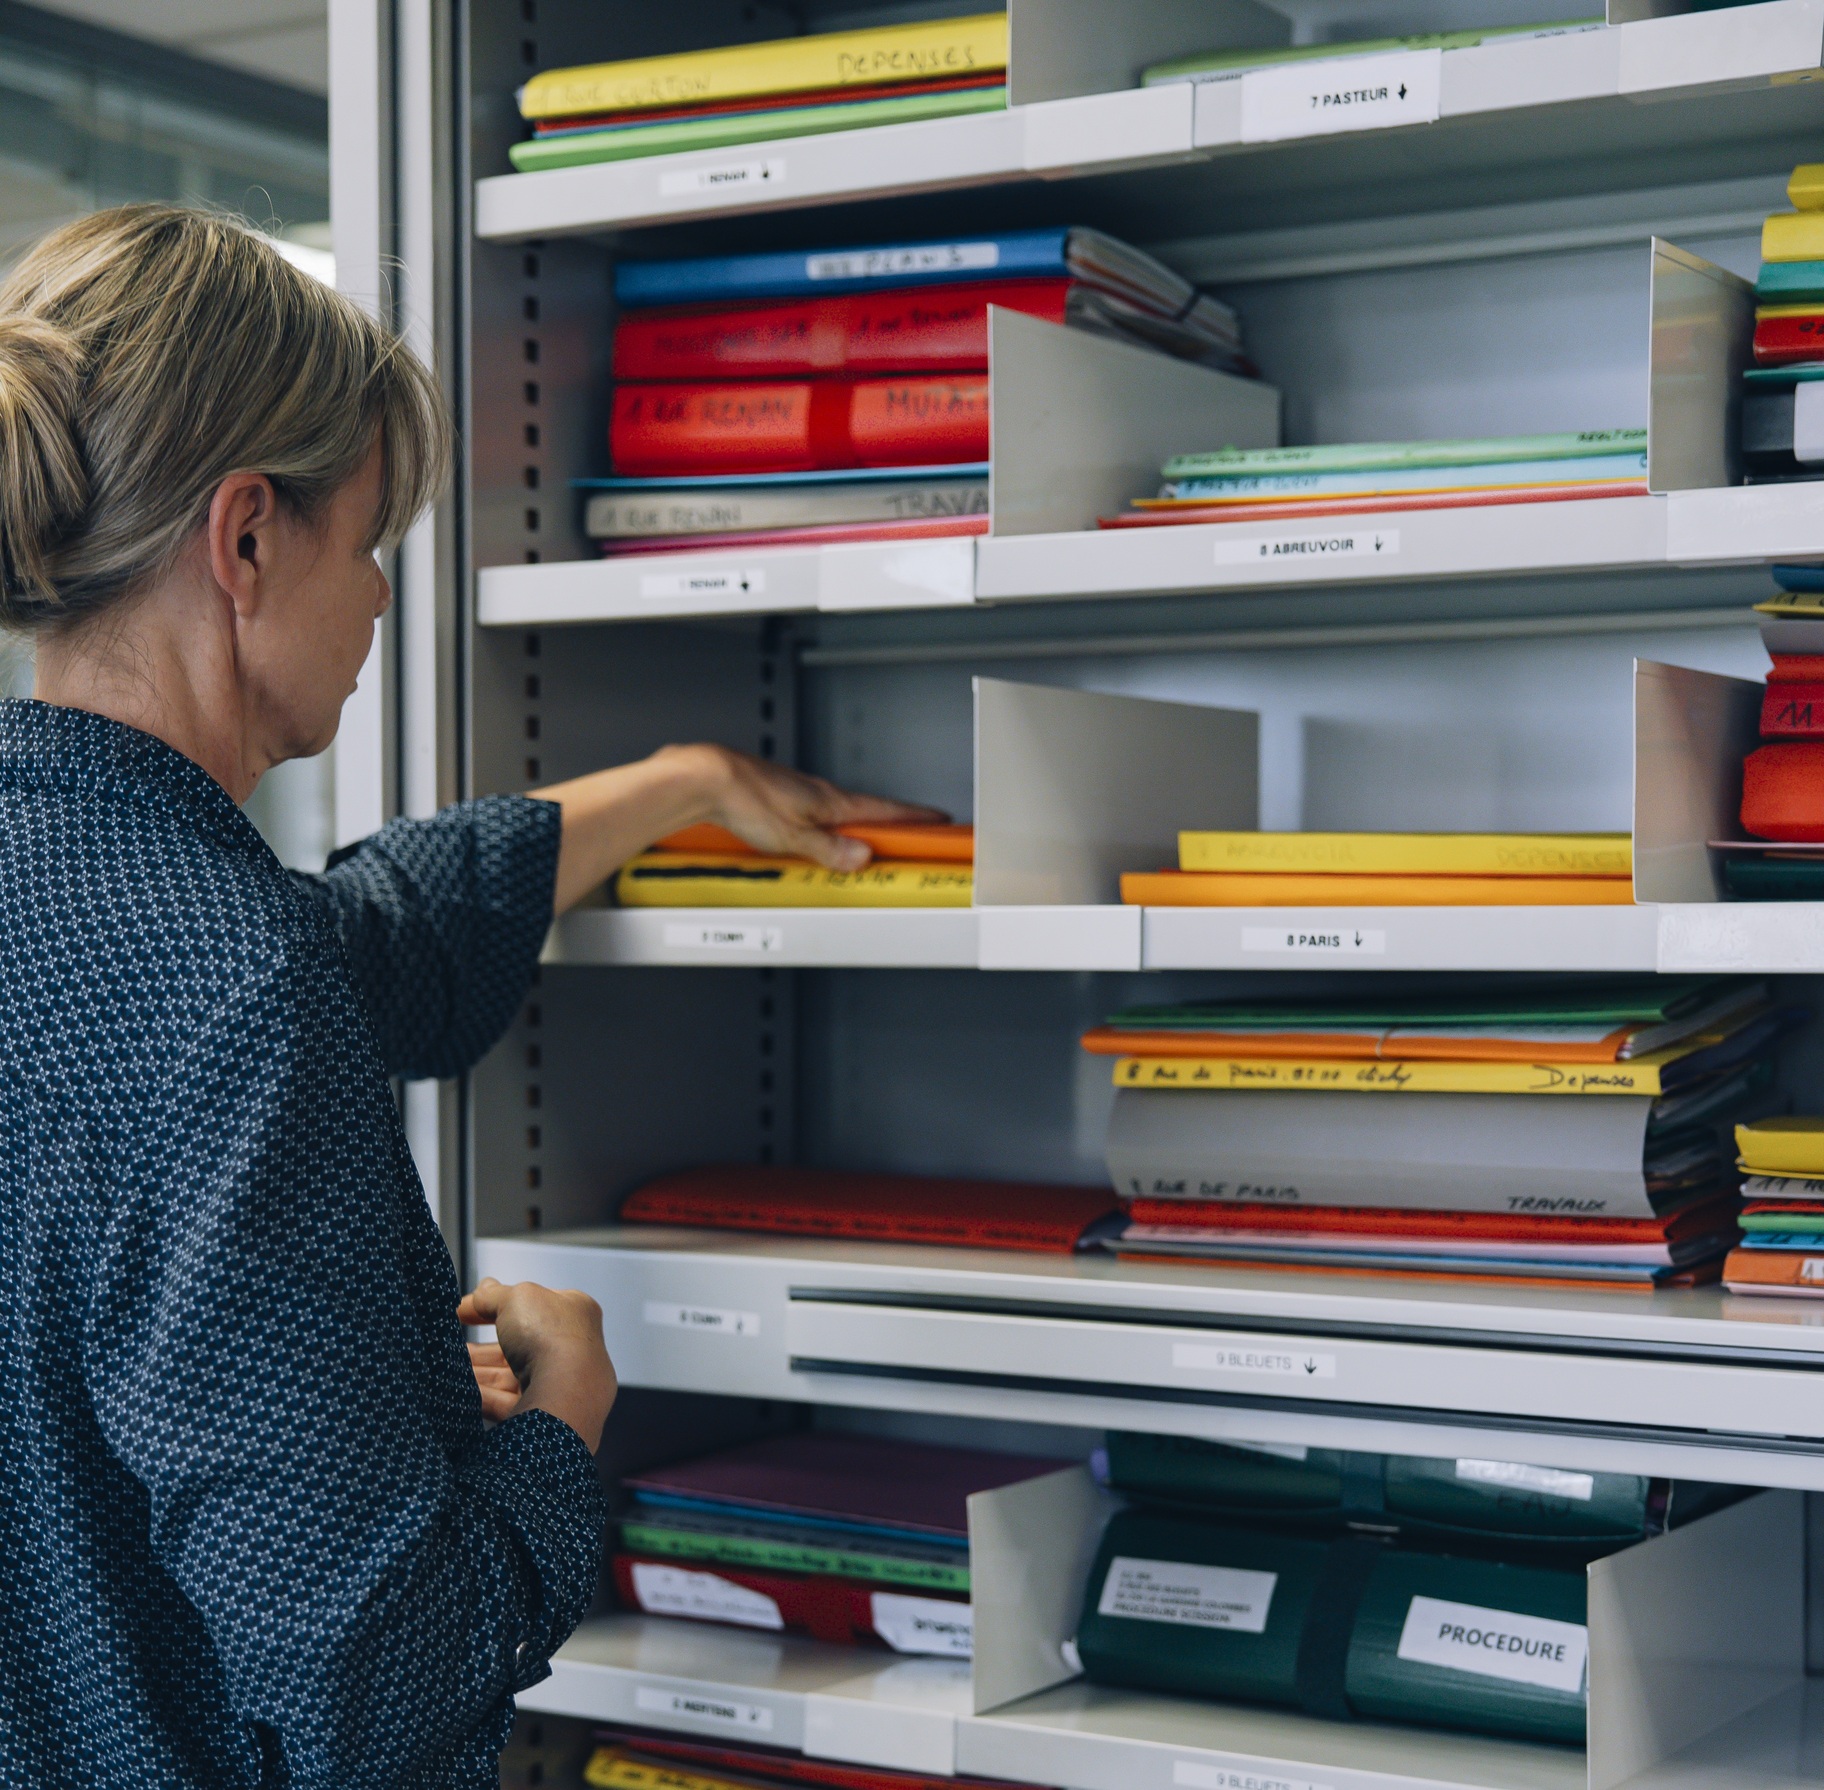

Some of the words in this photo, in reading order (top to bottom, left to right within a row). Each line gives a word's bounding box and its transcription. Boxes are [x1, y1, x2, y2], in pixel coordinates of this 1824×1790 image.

[1311, 96, 1319, 109] 7
[1323, 87, 1389, 106] PASTEUR
[1273, 538, 1354, 555] ABREUVOIR
[1300, 934, 1341, 948] PARIS
[1507, 1196, 1607, 1212] TRAVAUX
[1216, 1351, 1225, 1365] 9
[1228, 1353, 1292, 1371] BLEUETS
[1438, 1622, 1568, 1662] PROCEDURE
